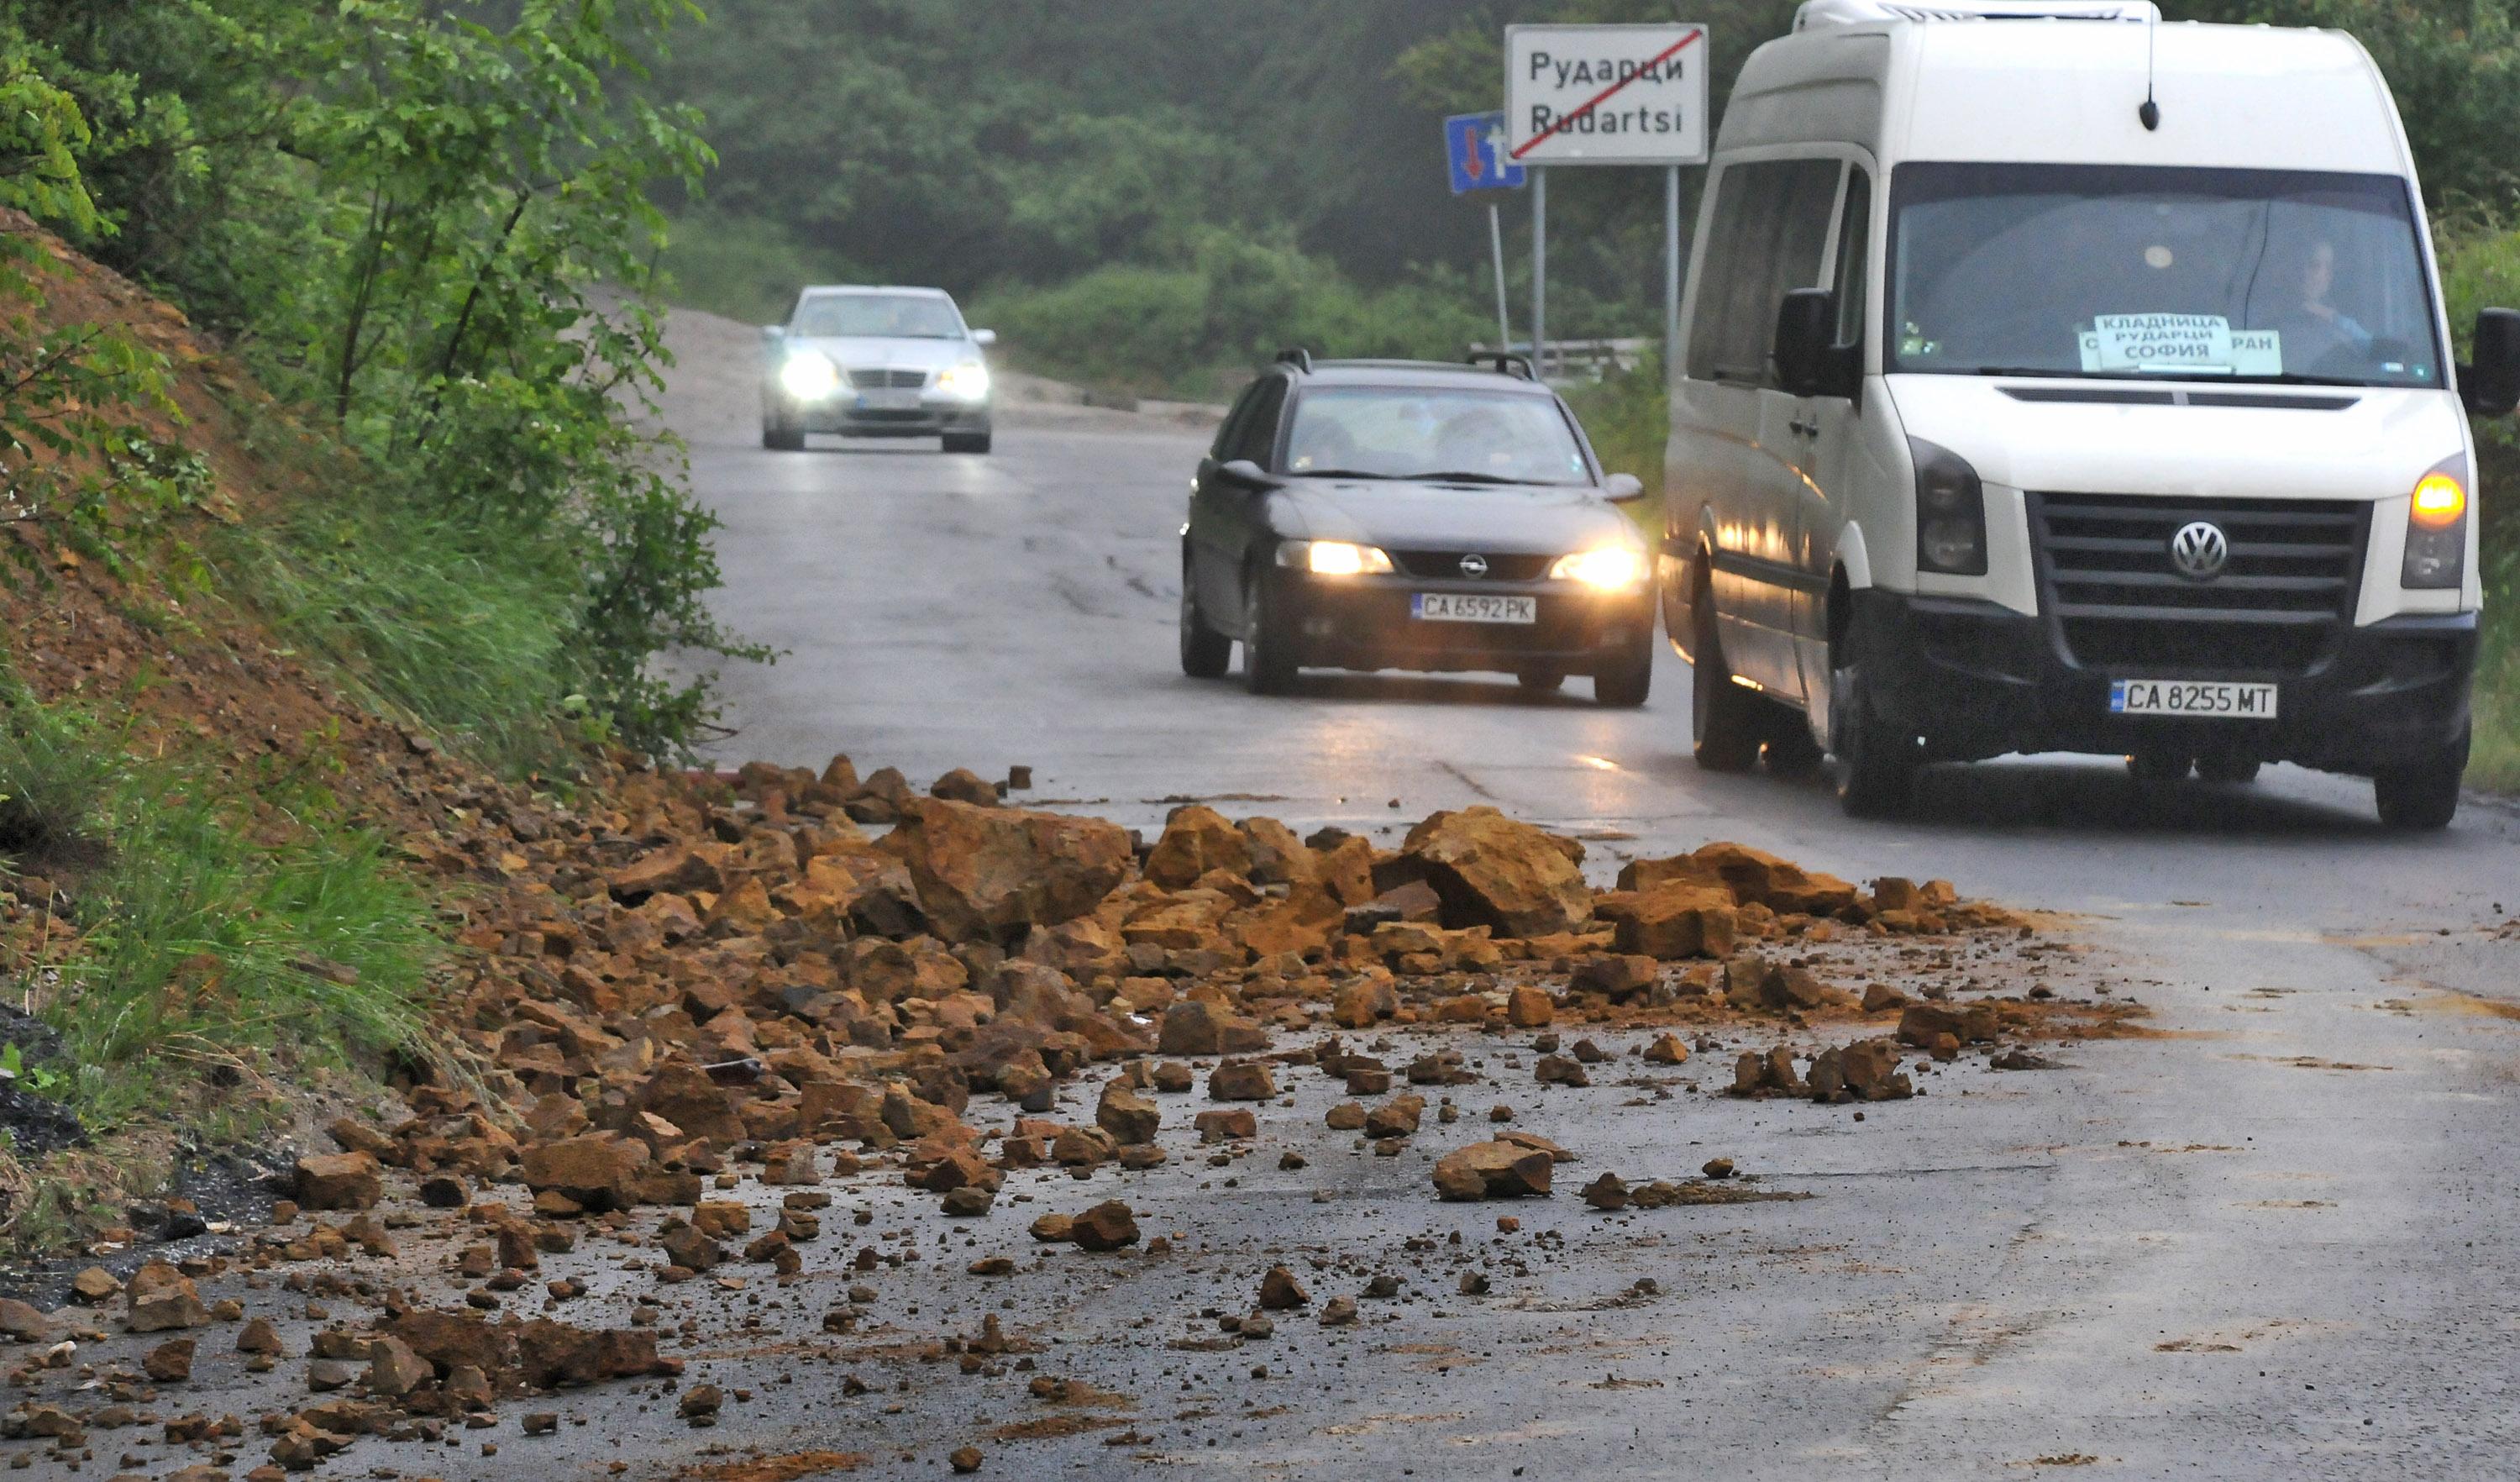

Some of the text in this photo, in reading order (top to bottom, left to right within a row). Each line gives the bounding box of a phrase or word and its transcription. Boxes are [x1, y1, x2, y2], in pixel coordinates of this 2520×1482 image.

[1530, 52, 1683, 87] Рударци
[1531, 104, 1683, 134] Rudartsi
[2103, 315, 2221, 330] КЛАДНИЦА
[2115, 330, 2213, 342] РУДАРЦИ
[2231, 337, 2272, 349] РАН
[2124, 344, 2209, 359] СОФИЯ
[2168, 686, 2231, 711] 8255
